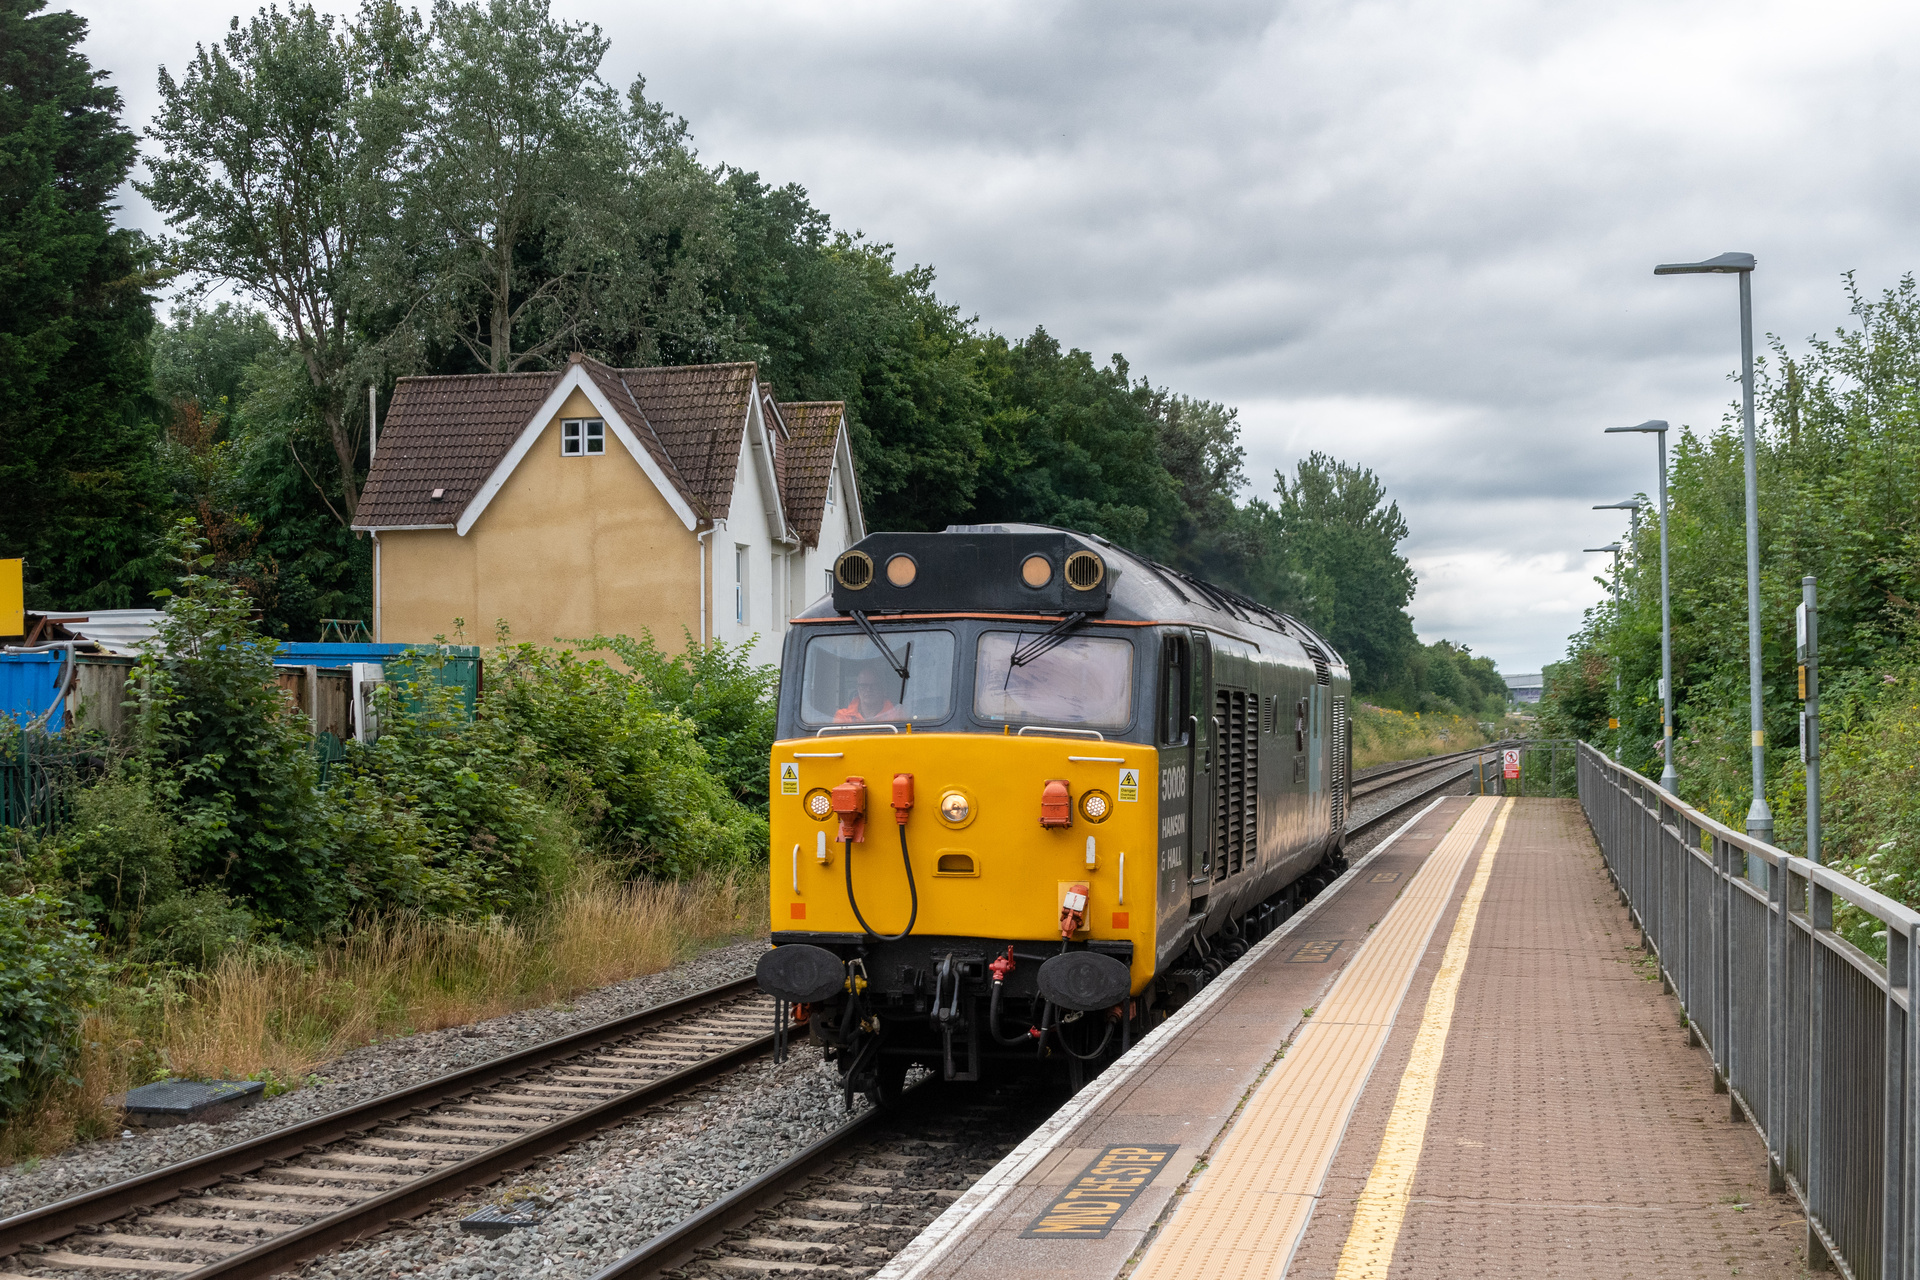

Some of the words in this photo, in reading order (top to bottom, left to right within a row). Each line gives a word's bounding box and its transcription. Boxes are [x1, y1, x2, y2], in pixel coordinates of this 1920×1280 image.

[1162, 765, 1186, 801] 50008
[1161, 812, 1186, 839] HANSON
[1167, 846, 1182, 870] HALL
[1090, 1147, 1168, 1176] STEP
[1064, 1176, 1146, 1199] THE
[1032, 1201, 1122, 1233] MIND
